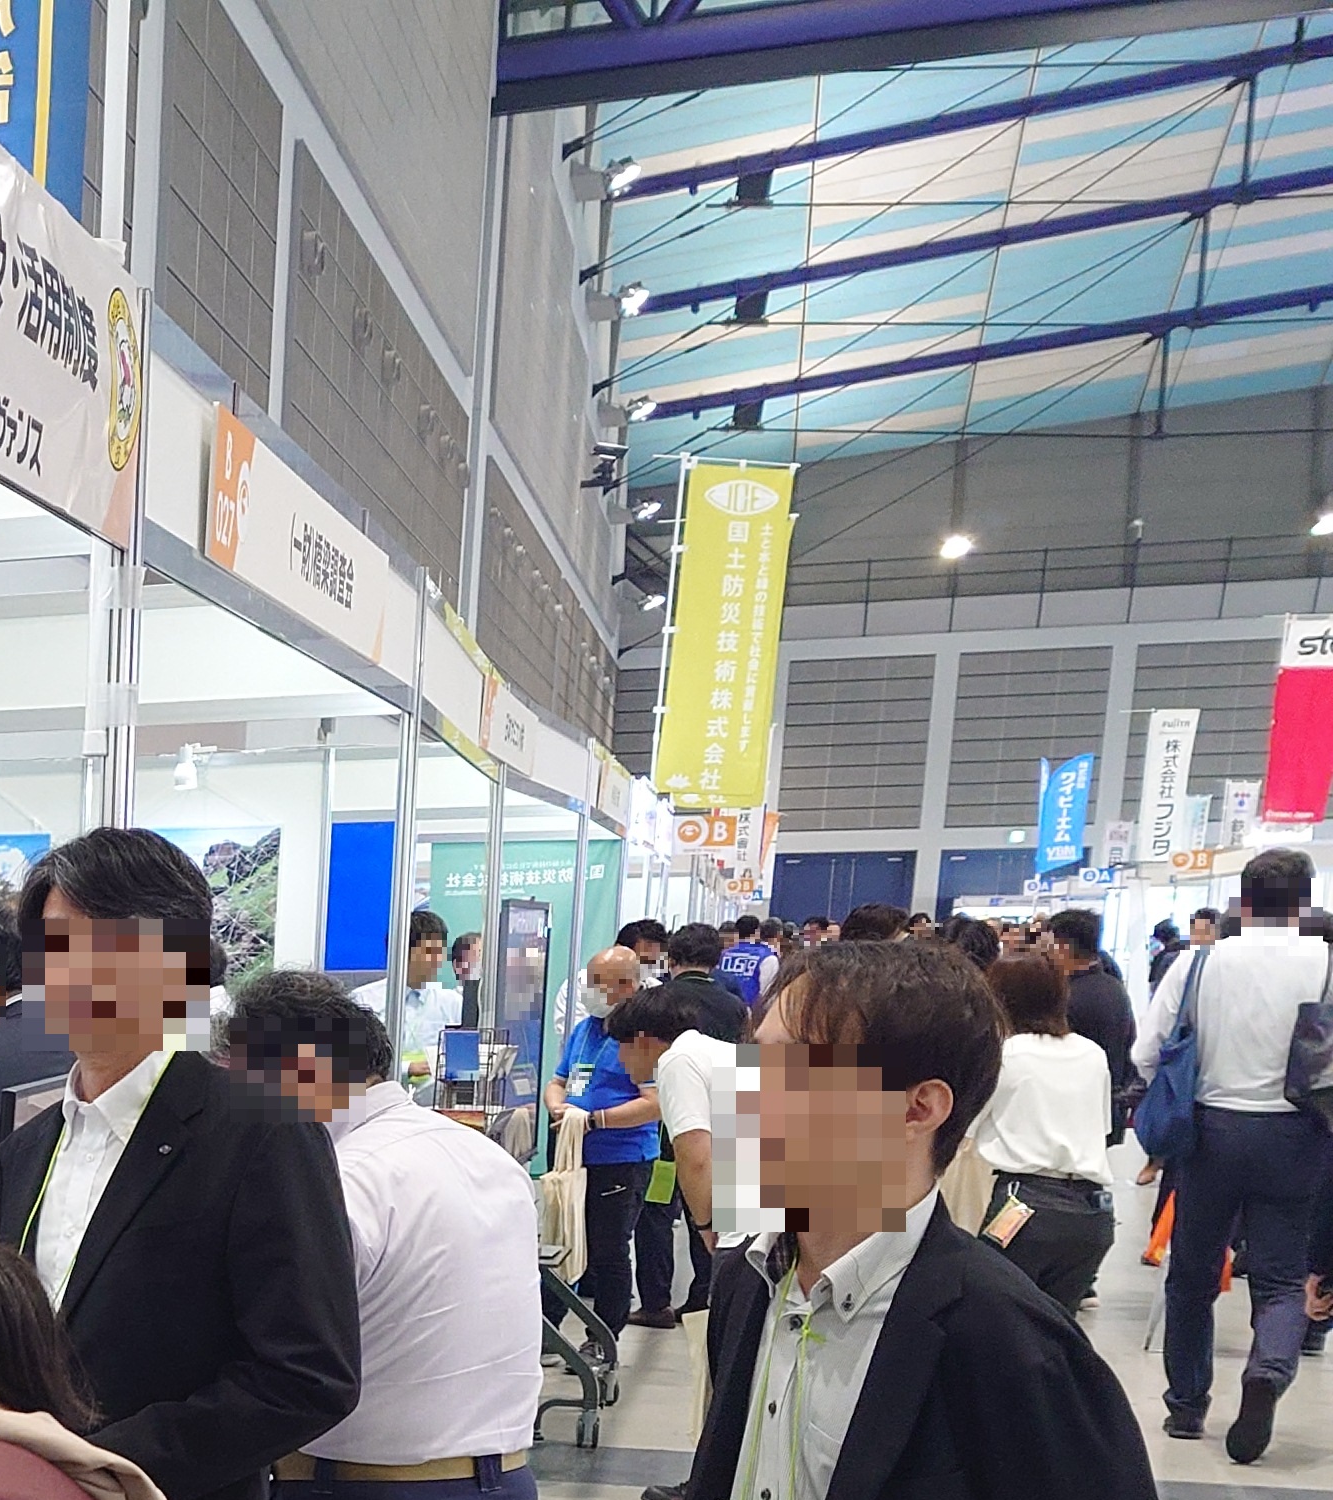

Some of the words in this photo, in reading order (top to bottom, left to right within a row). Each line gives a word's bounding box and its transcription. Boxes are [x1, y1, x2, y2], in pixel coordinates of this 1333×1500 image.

[216, 491, 235, 548] 027
[699, 521, 750, 790] 国土防災技術株式会社
[1159, 739, 1182, 799] 株式会社
[714, 821, 729, 842] B
[1054, 771, 1076, 843] ワイビーエム
[1152, 803, 1175, 856] フジタ
[1099, 872, 1111, 881] A
[1196, 853, 1208, 867] B
